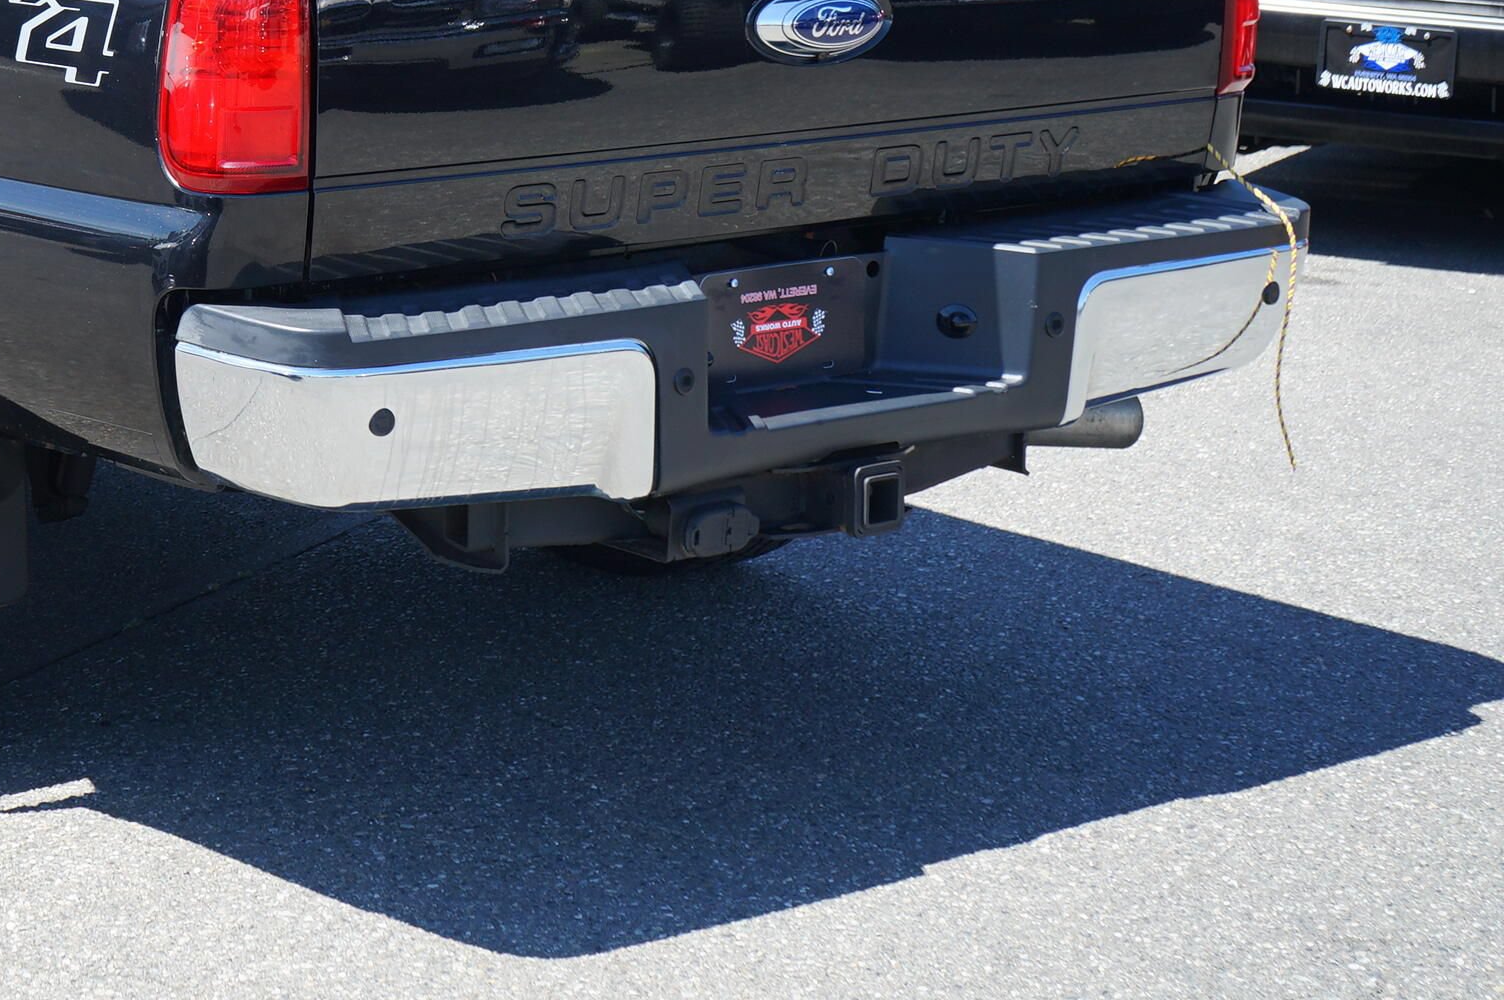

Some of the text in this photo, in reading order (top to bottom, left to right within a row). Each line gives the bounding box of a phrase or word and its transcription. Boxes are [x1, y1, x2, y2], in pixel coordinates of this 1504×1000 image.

[811, 6, 865, 38] Ford
[1331, 73, 1437, 98] WCAUTOWORKS.COM
[499, 125, 1080, 240] SUPER DUTY
[763, 289, 778, 301] WA
[777, 284, 817, 299] EVERETT,
[755, 319, 802, 332] AUTO WORKS
